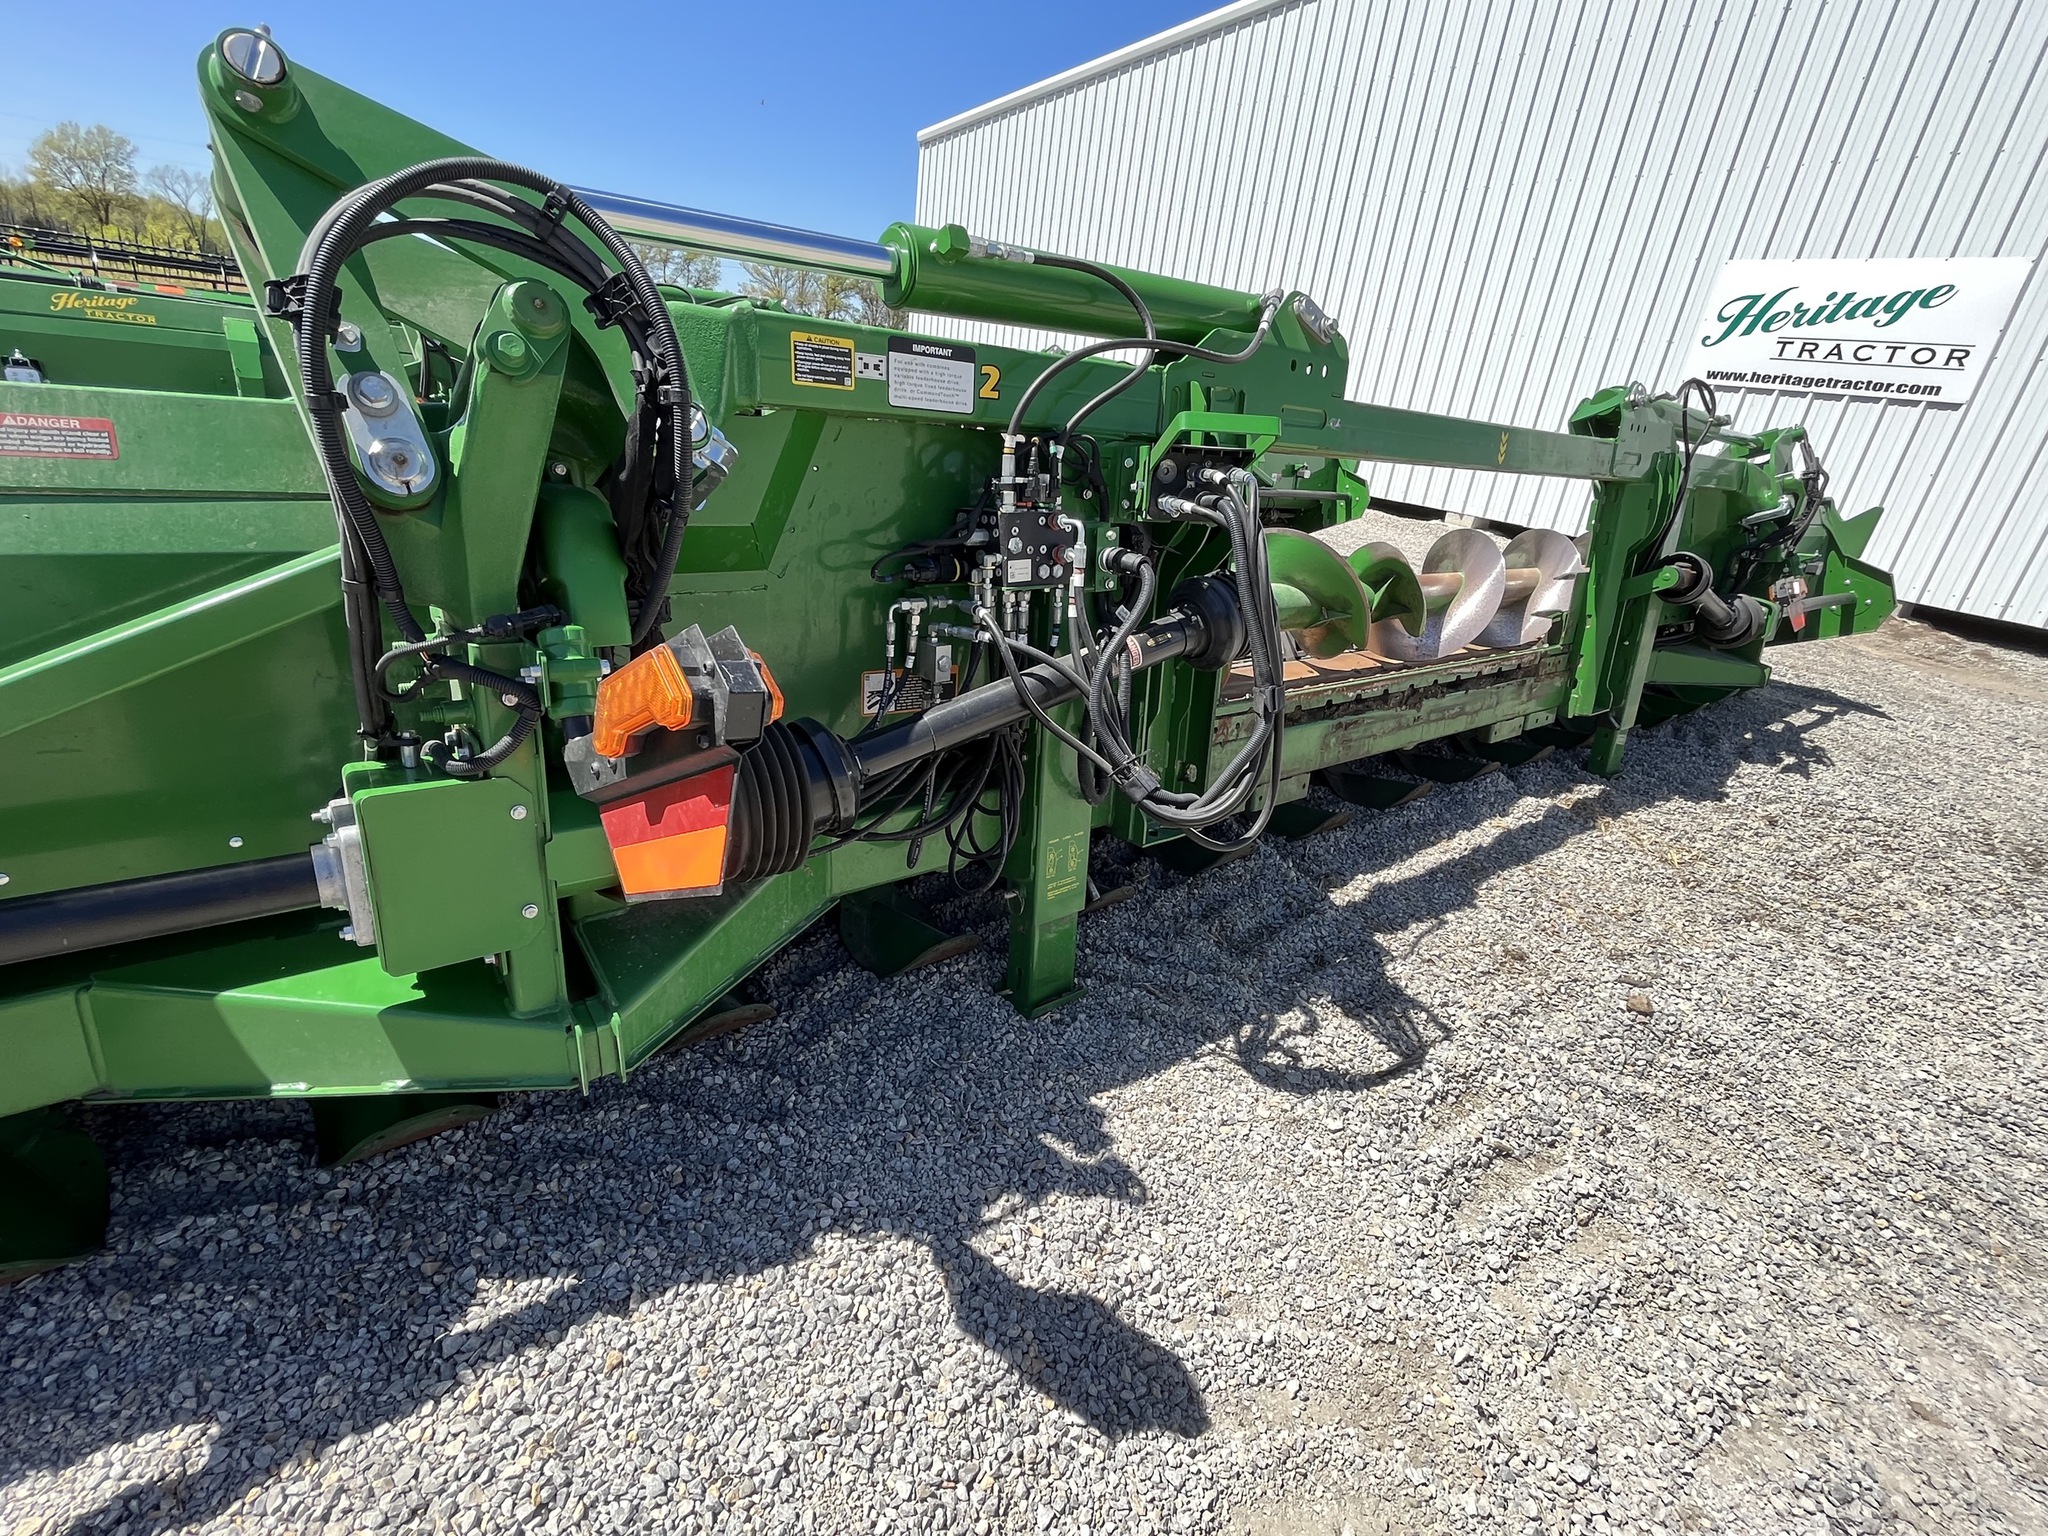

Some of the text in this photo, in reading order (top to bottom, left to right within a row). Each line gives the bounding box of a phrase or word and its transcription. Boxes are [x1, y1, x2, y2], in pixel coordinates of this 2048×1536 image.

[49, 292, 139, 311] Heritage
[85, 309, 156, 323] TRACTOR
[1701, 284, 1960, 348] Heritage
[813, 336, 840, 345] CAUTION
[912, 344, 953, 357] IMPORTANT
[1776, 340, 1972, 367] TRACTOR
[979, 365, 1000, 399] 2
[1706, 369, 1942, 397] www.heritagetractor.com
[16, 416, 81, 429] DANGER
